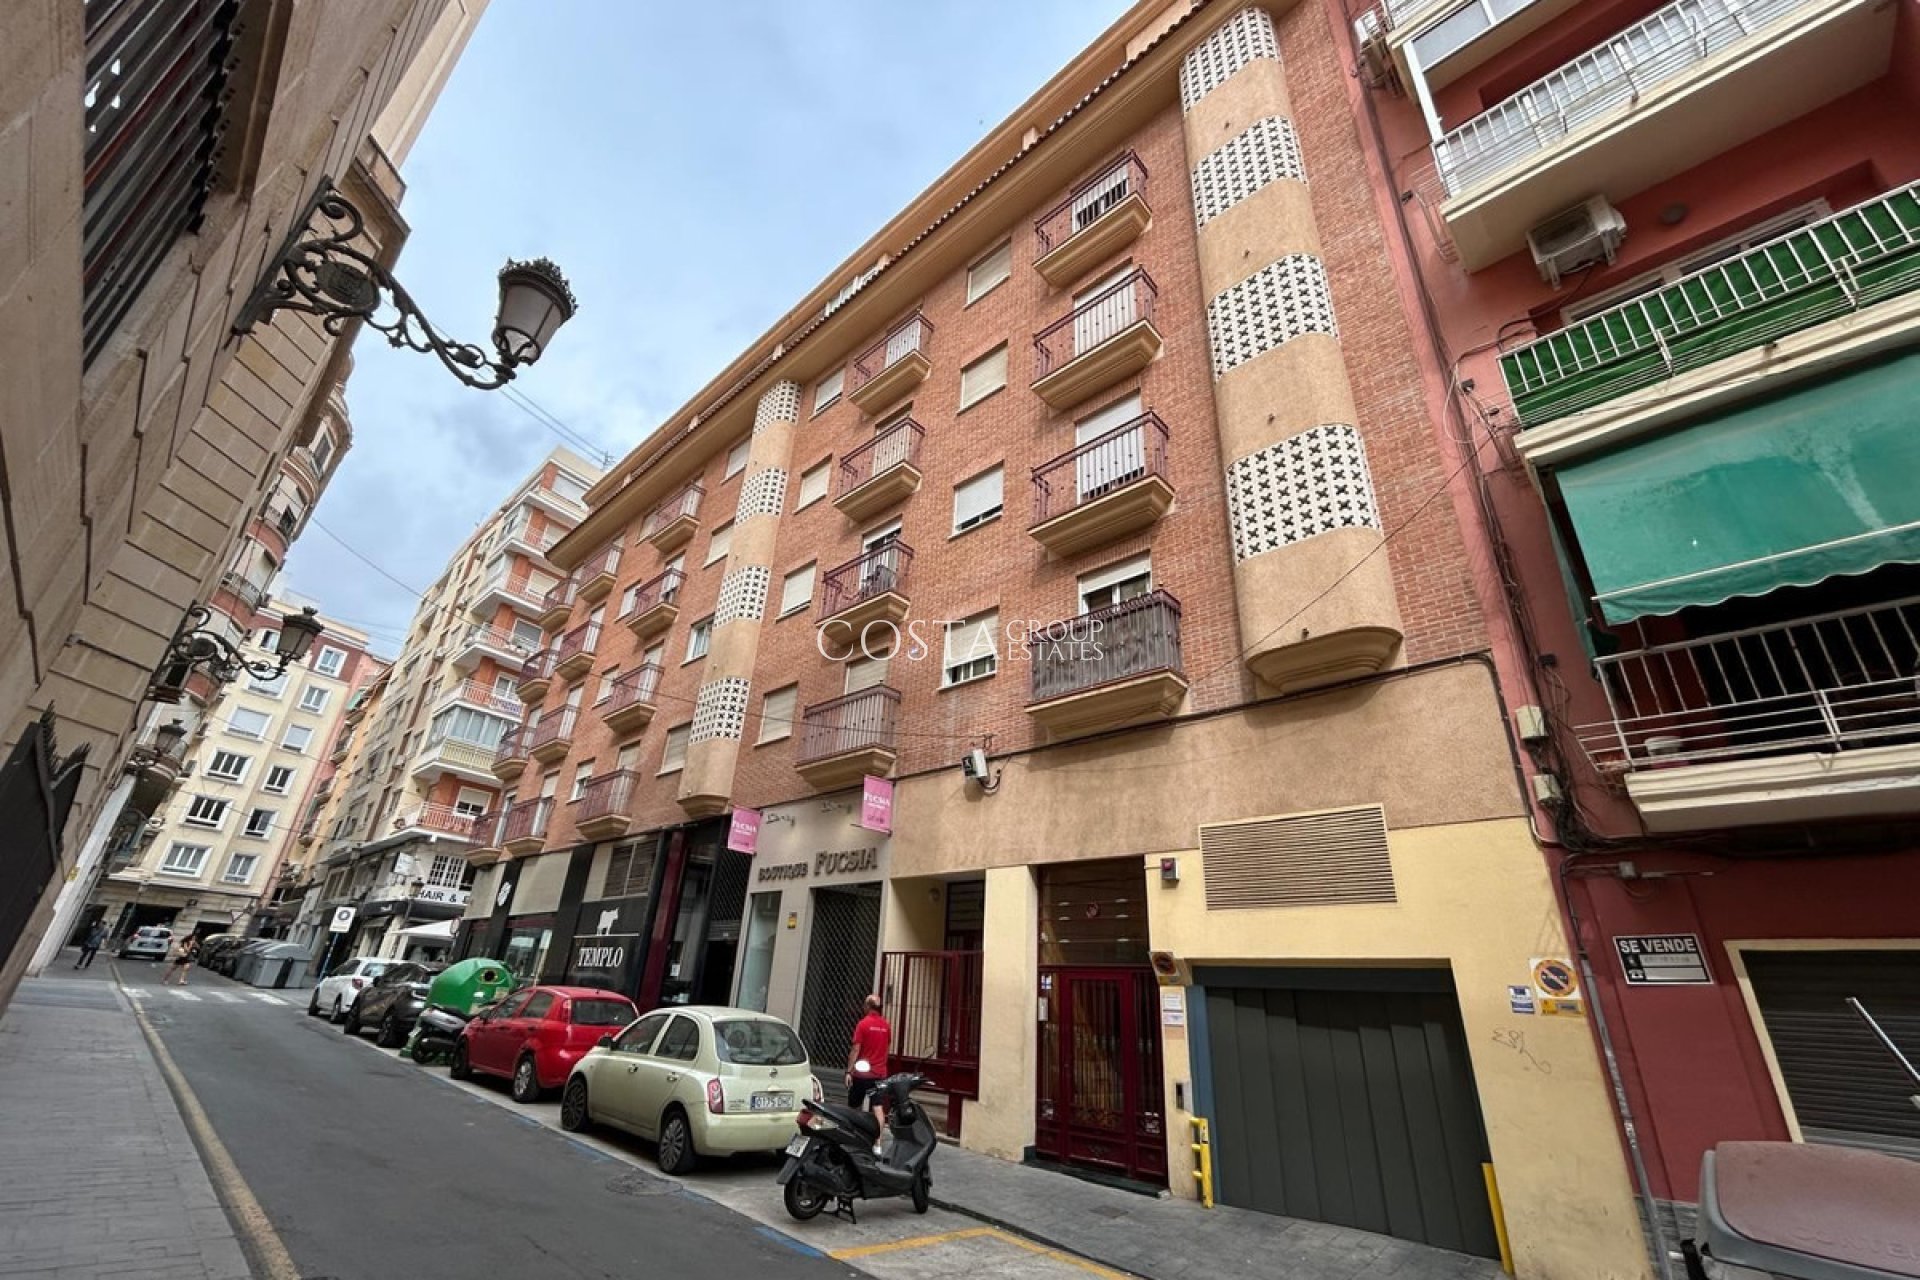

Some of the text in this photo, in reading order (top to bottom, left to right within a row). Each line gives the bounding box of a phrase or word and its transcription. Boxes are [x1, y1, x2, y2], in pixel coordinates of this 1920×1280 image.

[814, 848, 878, 876] FUCSIA
[1619, 938, 1697, 953] SE VENDE
[577, 946, 624, 968] TEMPLO
